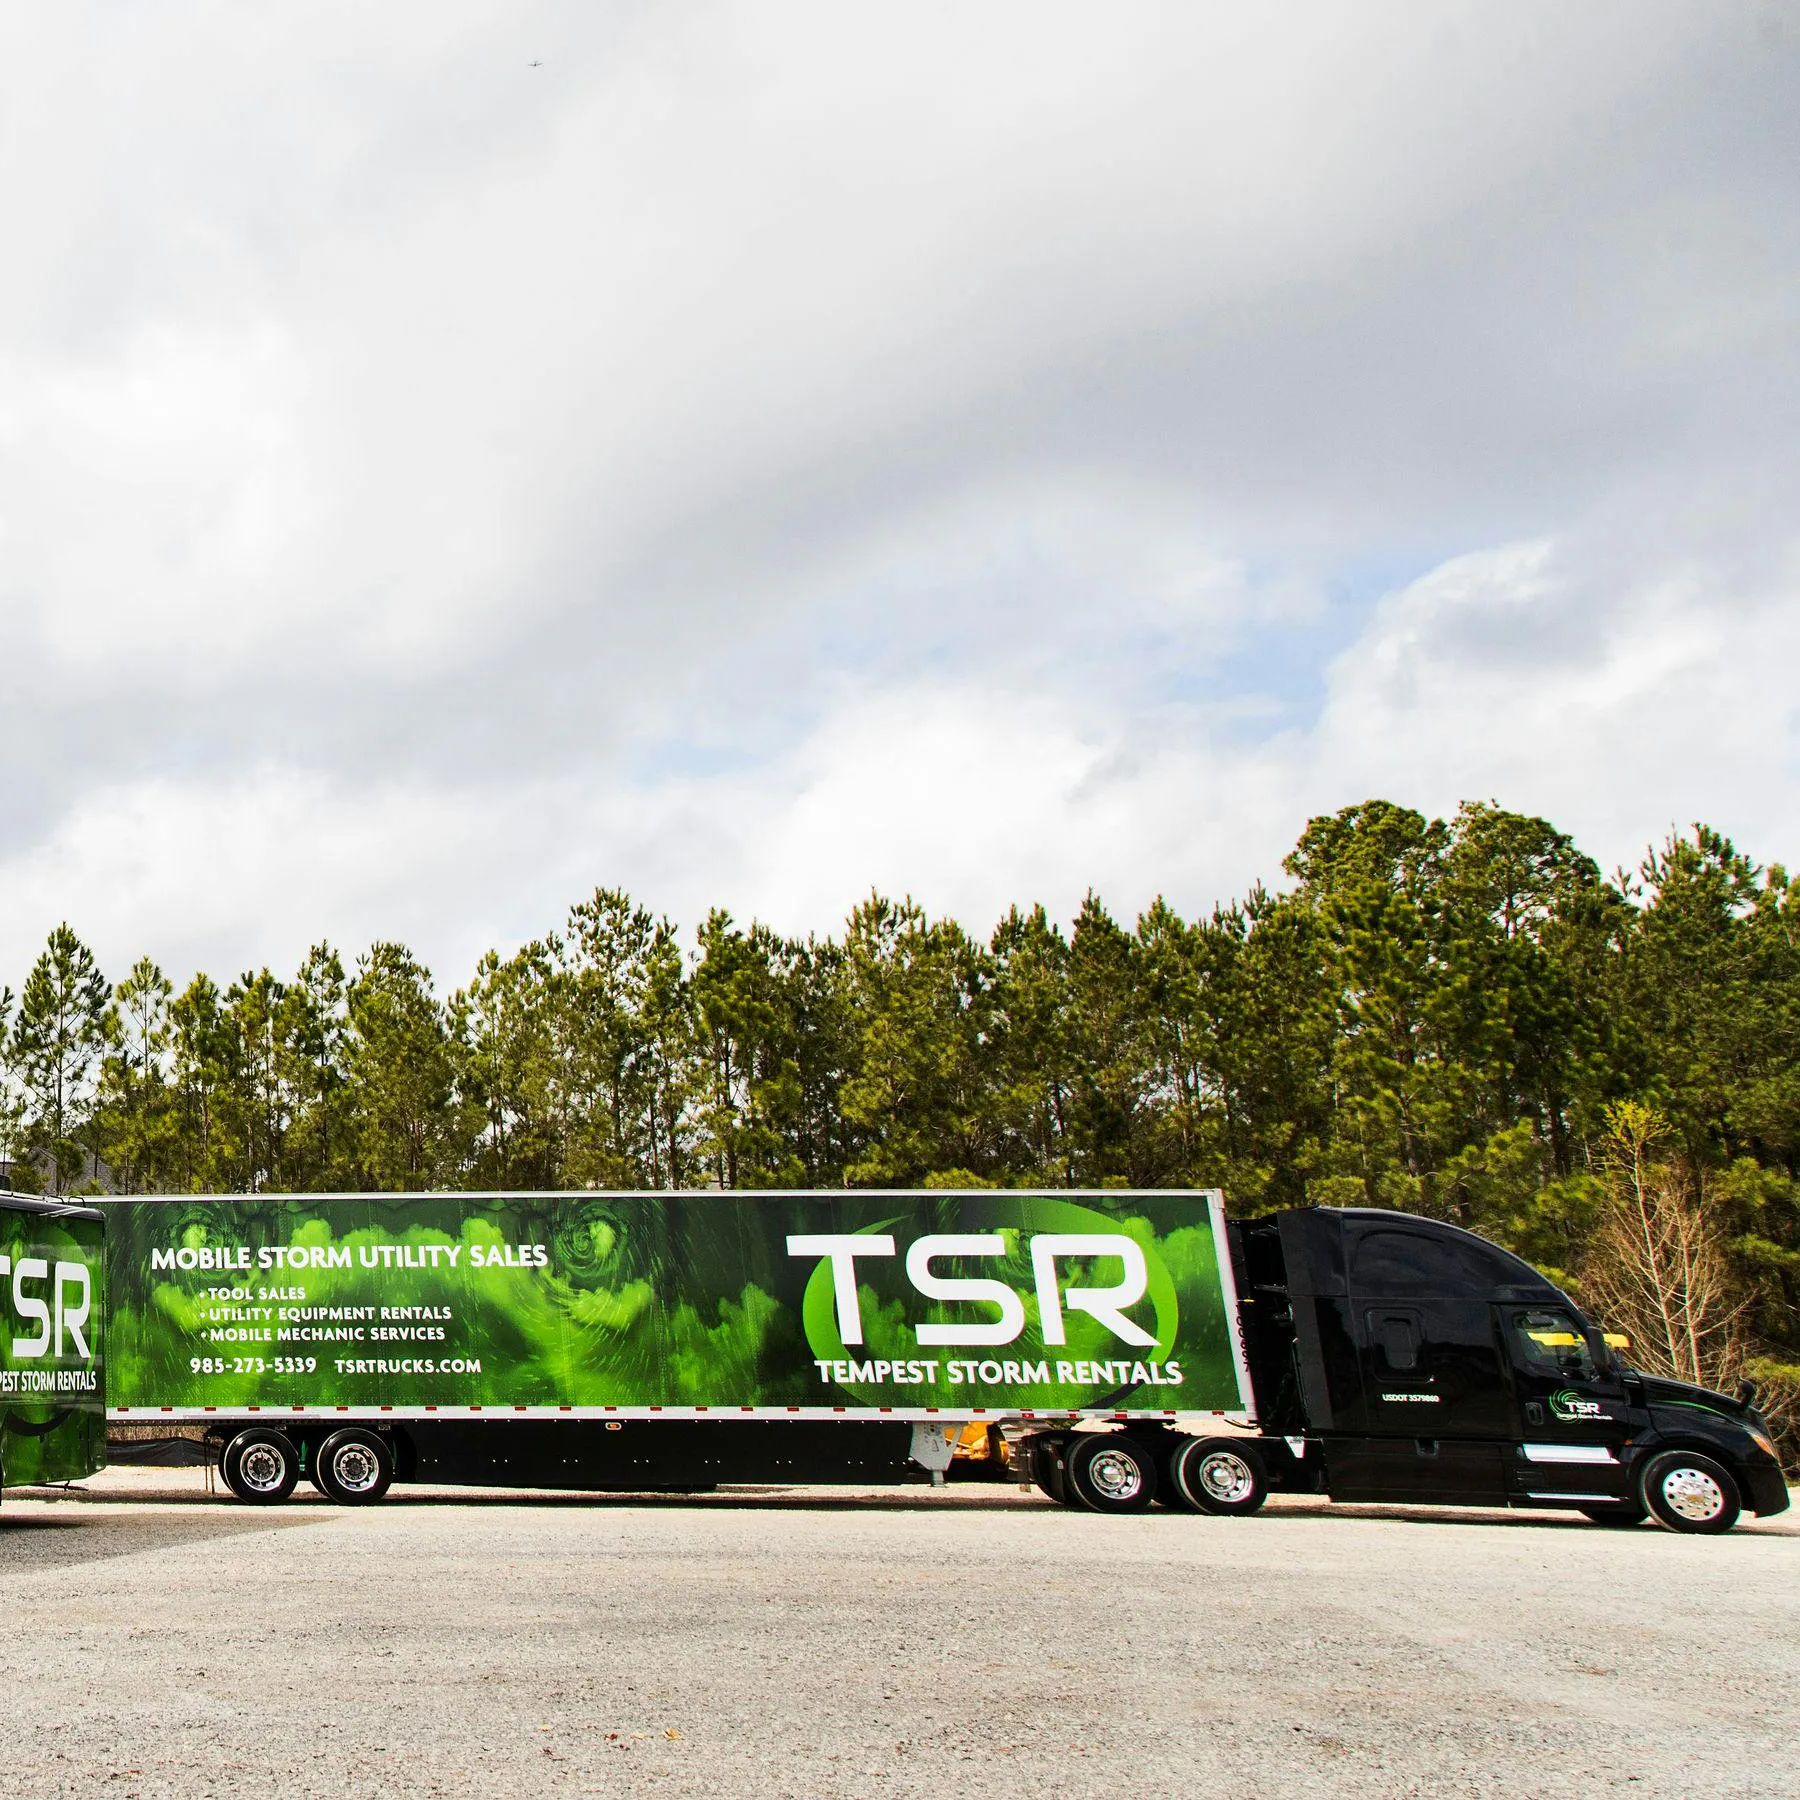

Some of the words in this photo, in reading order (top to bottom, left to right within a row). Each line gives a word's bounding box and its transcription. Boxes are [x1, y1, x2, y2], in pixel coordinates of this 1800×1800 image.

[151, 1246, 253, 1269] MOBILE
[258, 1245, 353, 1268] STORM
[358, 1244, 464, 1268] UTILITY
[469, 1244, 548, 1267] SALES
[208, 1286, 253, 1301] TOOL
[258, 1286, 306, 1301] SALES
[786, 1234, 1162, 1345] TSR
[209, 1307, 273, 1322] UTILITY
[278, 1306, 375, 1322] EQUIPMENT
[380, 1306, 452, 1321] RENTALS
[210, 1328, 272, 1343] MOBILE
[277, 1327, 365, 1342] MECHANIC
[370, 1326, 446, 1342] SERVICES
[190, 1357, 317, 1374] 985-273-5339
[334, 1358, 482, 1374] TSRTRUCKS.COM
[814, 1360, 939, 1384] TEMPEST
[947, 1360, 1050, 1384] STORM
[1057, 1361, 1183, 1385] RENTALS
[21, 1370, 56, 1392] STORM
[57, 1370, 97, 1391] RENTALS
[1381, 1394, 1408, 1402] USDOT
[1564, 1402, 1601, 1413] TSR
